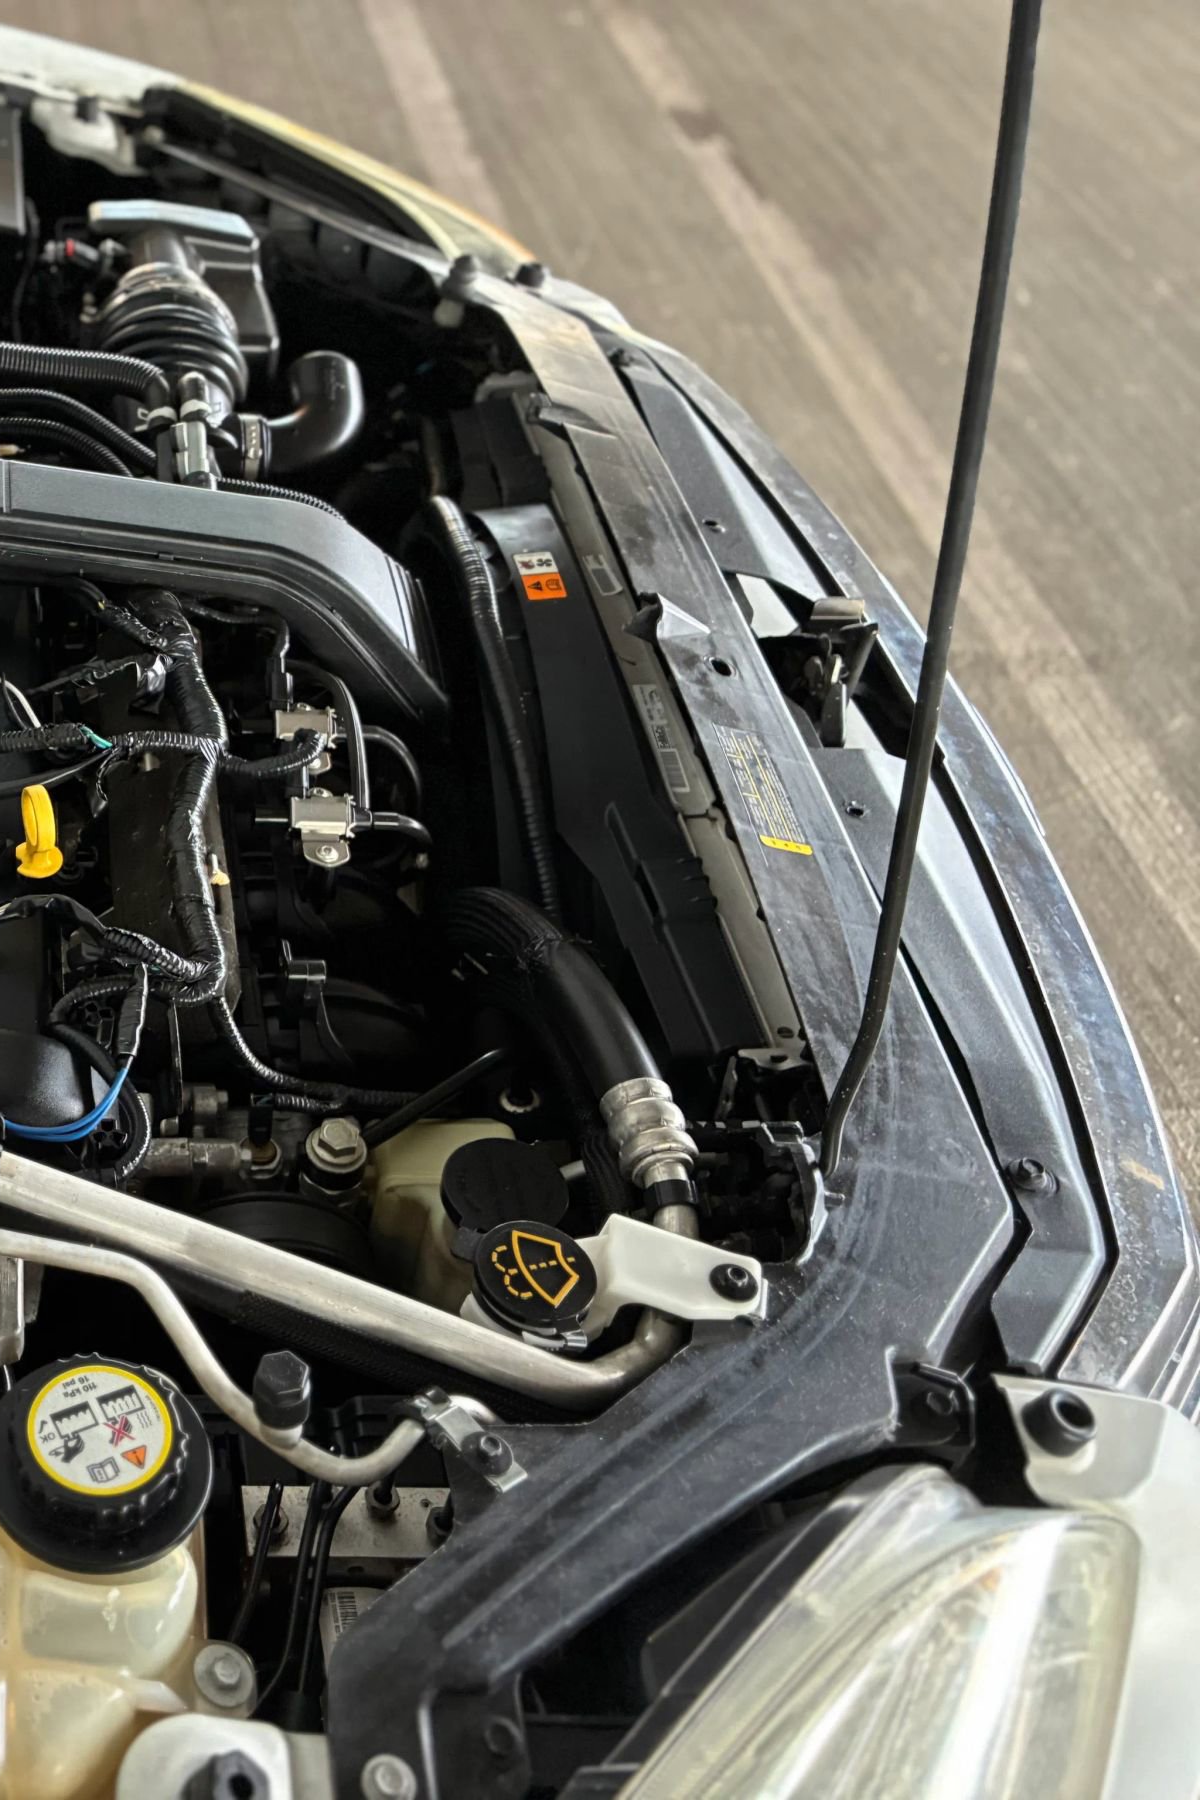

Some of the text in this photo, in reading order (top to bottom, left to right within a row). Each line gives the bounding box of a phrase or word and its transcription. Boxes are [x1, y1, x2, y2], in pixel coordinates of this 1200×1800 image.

[62, 1375, 89, 1389] 16 psi
[63, 1383, 97, 1398] 110 kPa
[39, 1431, 56, 1444] OK
